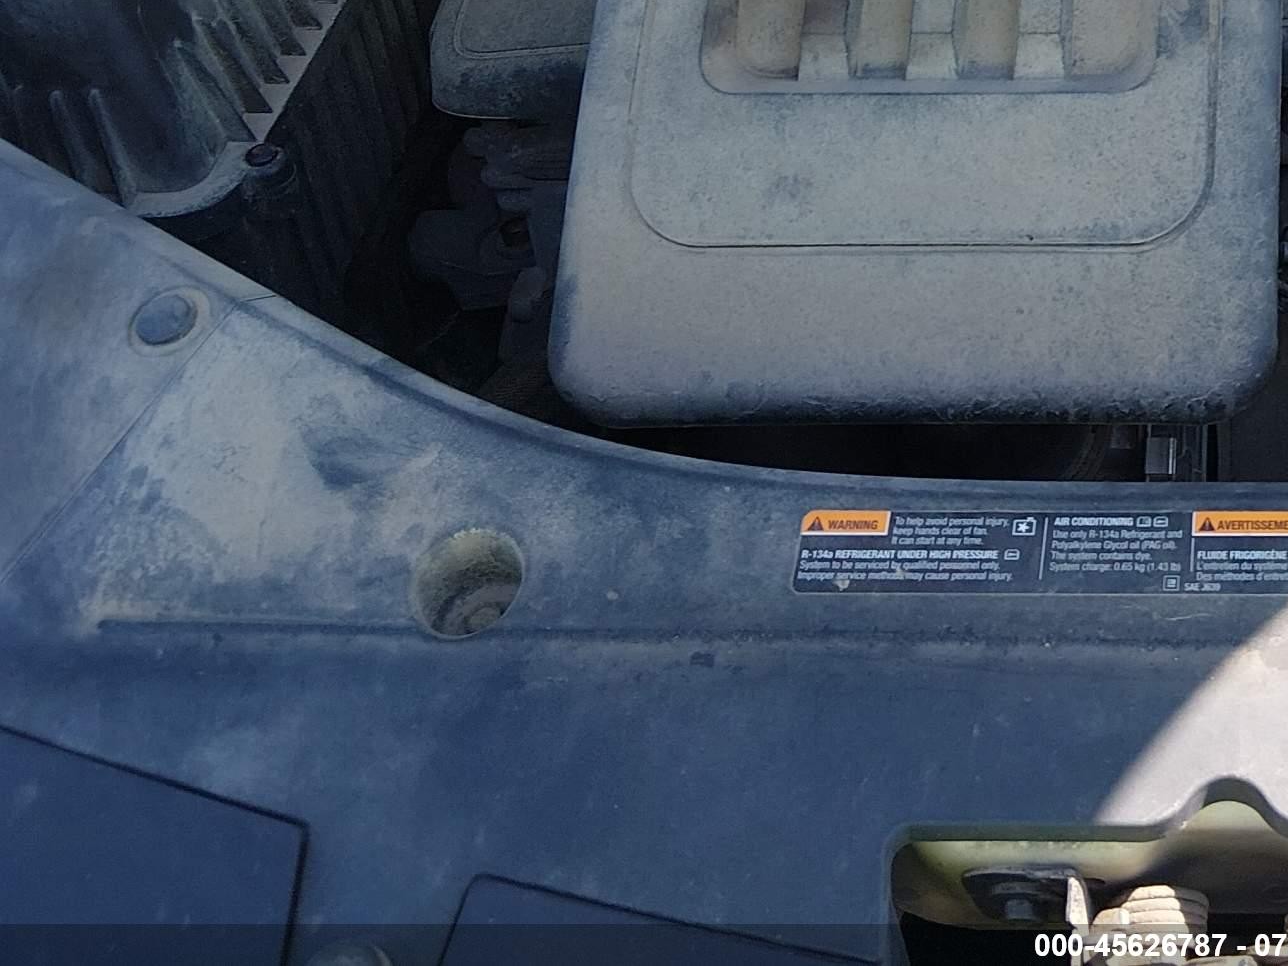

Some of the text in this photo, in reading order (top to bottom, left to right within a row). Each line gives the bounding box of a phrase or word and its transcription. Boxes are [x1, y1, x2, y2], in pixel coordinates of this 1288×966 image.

[828, 520, 879, 530] WARNING
[895, 517, 904, 525] To
[906, 517, 924, 526] help
[925, 518, 948, 526] avoid
[949, 517, 984, 527] personal
[1054, 517, 1134, 526] AIR CONDITIONING
[892, 527, 914, 536] keep
[915, 527, 940, 535] hands
[941, 527, 961, 535] clear
[962, 527, 972, 535] of
[1053, 529, 1183, 540] Use only R-134a Refrigerant and
[916, 537, 935, 545] start
[936, 537, 946, 545] at
[946, 537, 962, 546] any
[1103, 540, 1128, 550] Glycol
[1129, 541, 1140, 549] oil
[801, 550, 999, 559] R-134a REFRIGERANT UNDER HIGH PRESSURE
[1051, 551, 1067, 560] The
[1068, 552, 1098, 562] system
[1099, 551, 1133, 560] contains
[1197, 550, 1229, 560] FLUIDE
[1229, 549, 1288, 560] FRIGORIGÈNE
[800, 560, 830, 570] System
[832, 560, 841, 569] to
[842, 560, 853, 569] be
[855, 561, 889, 569] serviced
[891, 561, 902, 570] by
[902, 561, 938, 570] qualified
[939, 561, 980, 571] personnel
[1049, 562, 1081, 572] System
[1113, 562, 1133, 571] 0.65
[1134, 562, 1146, 573] kg
[1147, 562, 1169, 572] (1.43
[1241, 562, 1253, 571] du
[798, 572, 834, 581] Improper
[835, 572, 867, 580] service
[905, 573, 924, 581] may
[925, 572, 949, 580] cause
[950, 572, 987, 581] personal
[1197, 573, 1212, 581] Des
[1214, 572, 1255, 581] méthodes
[1184, 582, 1200, 591] SAE
